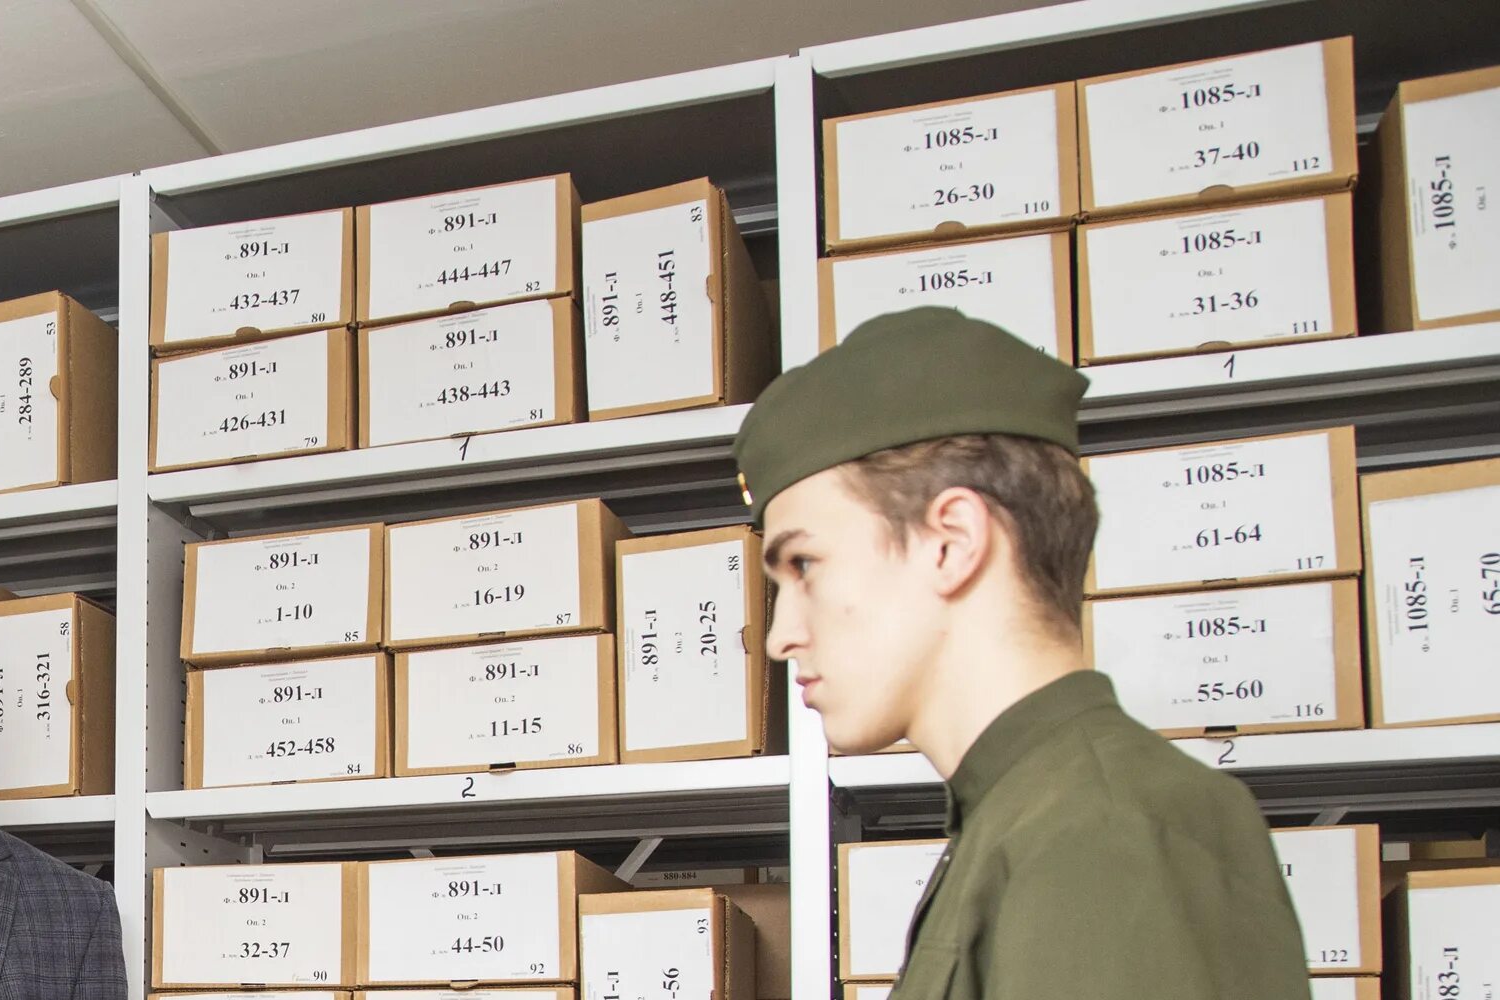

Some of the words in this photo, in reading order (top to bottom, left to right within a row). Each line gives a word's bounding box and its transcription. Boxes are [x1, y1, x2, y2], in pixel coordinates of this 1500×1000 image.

[1182, 83, 1261, 109] 1085-л
[925, 126, 998, 150] 1085-л
[1194, 141, 1260, 168] 37-40
[1293, 156, 1320, 172] 112
[934, 183, 995, 206] 26-30
[1430, 155, 1456, 229] 1085-л
[690, 206, 702, 223] 83
[1024, 200, 1050, 215] 110
[444, 212, 497, 232] 891-л
[239, 240, 289, 259] 891-л
[1182, 229, 1261, 254] 1085-л
[436, 259, 512, 285] 444-447
[919, 269, 992, 292] 1085-л
[525, 280, 541, 293] 82
[657, 250, 678, 325] 448-451
[229, 288, 300, 310] 432-437
[601, 271, 620, 327] 891-л
[1192, 290, 1259, 315] 31-36
[311, 312, 326, 323] 80
[1293, 320, 1318, 335] 111
[46, 321, 56, 336] 53
[445, 328, 498, 349] 891-л
[228, 360, 277, 380] 891-л
[1223, 353, 1235, 379] 1
[18, 357, 32, 425] 284-289
[436, 379, 511, 405] 438-443
[219, 409, 285, 433] 426-431
[529, 408, 543, 420] 81
[304, 436, 318, 447] 79
[459, 437, 471, 460] 1
[1185, 461, 1265, 486] 1085-л
[469, 530, 522, 550] 891-л
[1195, 523, 1262, 548] 61-64
[269, 551, 319, 570] 891-л
[727, 555, 739, 572] 88
[1297, 555, 1324, 571] 117
[1405, 556, 1429, 631] 1085-л
[1480, 553, 1500, 616] 65-70
[474, 584, 525, 606] 16-19
[277, 603, 313, 622] 1-10
[556, 612, 572, 625] 87
[59, 621, 70, 636] 58
[344, 630, 359, 642] 85
[641, 609, 659, 666] 891-л
[699, 600, 718, 656] 20-25
[1187, 616, 1266, 639] 1085-л
[485, 662, 539, 681] 891-л
[36, 653, 51, 721] 316-321
[273, 685, 322, 703] 891-л
[1197, 680, 1264, 703] 55-60
[1296, 703, 1324, 718] 116
[491, 717, 542, 737] 11-15
[265, 737, 335, 758] 452-458
[567, 743, 583, 755] 86
[1218, 741, 1236, 764] 2
[346, 763, 361, 775] 84
[461, 776, 477, 799] 2
[238, 887, 289, 904] 891-л
[448, 880, 502, 898] 891-л
[696, 918, 708, 934] 93
[239, 942, 291, 959] 32-37
[451, 936, 504, 954] 44-50
[1321, 949, 1348, 963] 122
[313, 970, 328, 981] 90
[529, 962, 545, 975] 92
